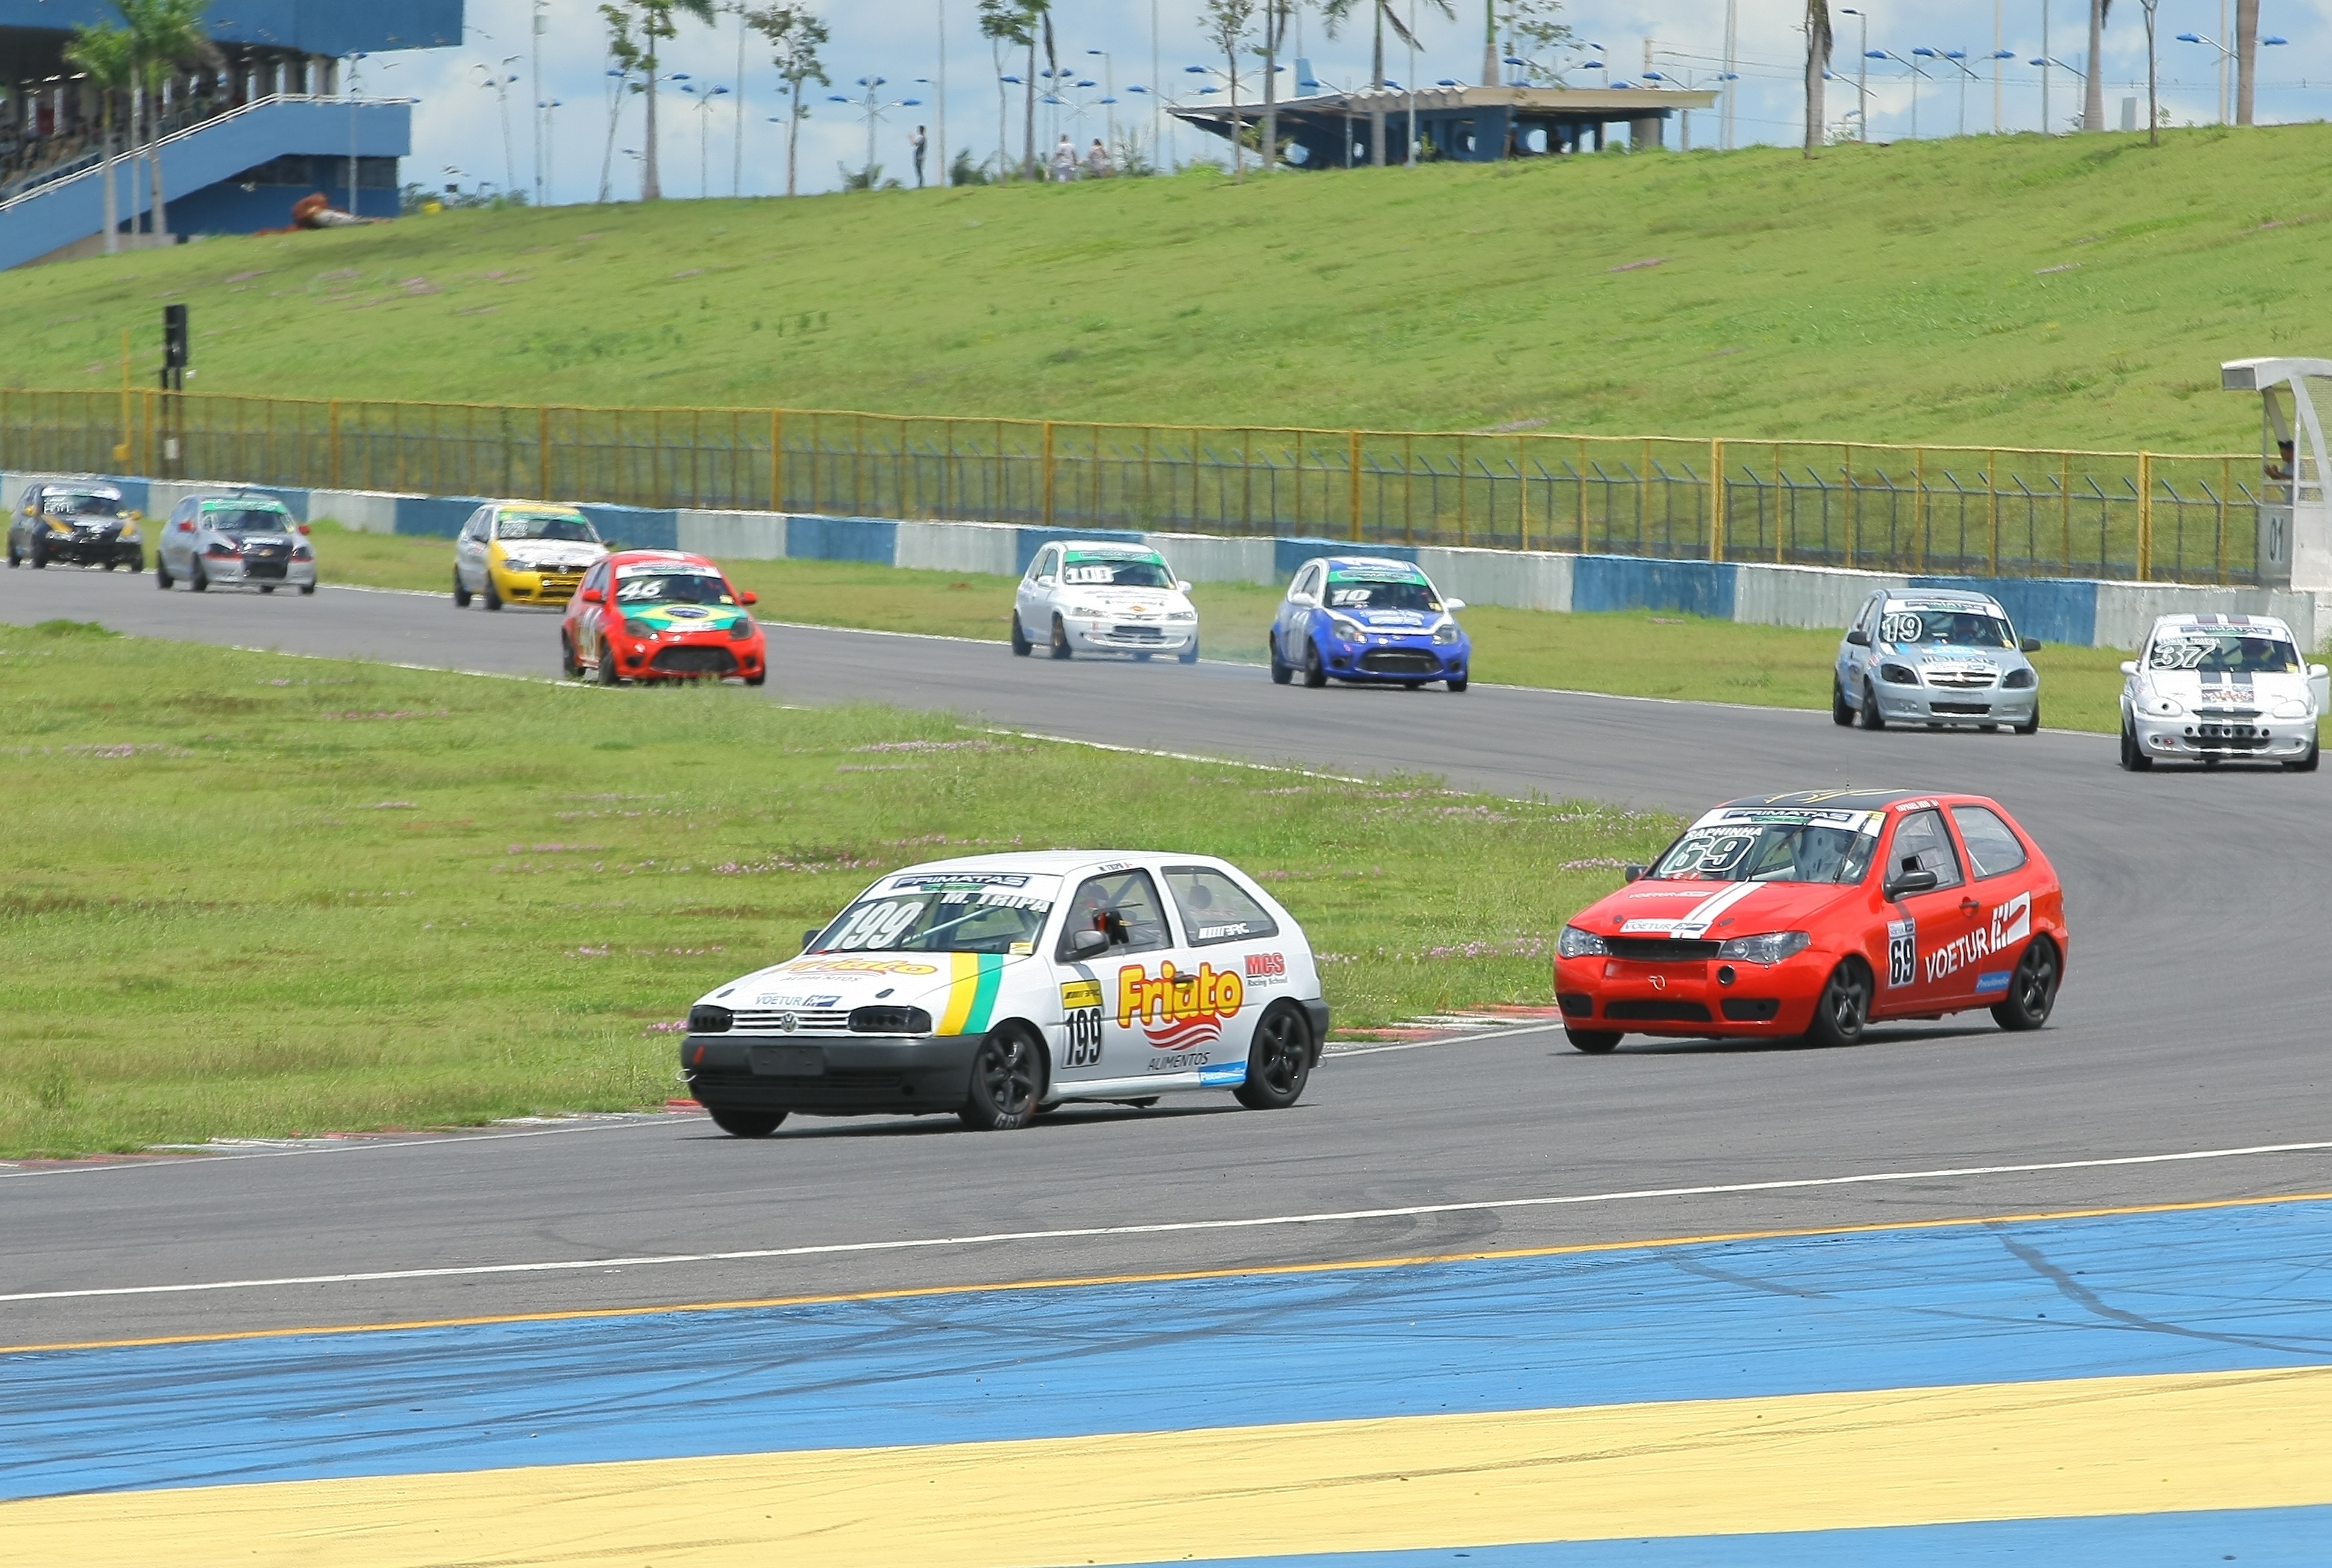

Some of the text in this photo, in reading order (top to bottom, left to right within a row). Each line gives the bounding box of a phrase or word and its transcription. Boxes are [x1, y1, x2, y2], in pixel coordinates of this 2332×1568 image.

[616, 580, 662, 600] 46
[1881, 613, 1922, 642] 19
[2151, 643, 2217, 669] 37
[1726, 810, 1850, 821] PRIMATAS
[1684, 827, 1763, 839] RAPHINHA
[1659, 835, 1756, 874] 69
[895, 876, 1026, 888] PRIMATAS
[979, 894, 1050, 912] TRIPA
[824, 901, 924, 950] 199
[1625, 922, 1672, 930] VOETUR
[1246, 953, 1286, 977] MCS
[1891, 938, 1914, 984] 69
[1925, 927, 1990, 983] VOETUR
[755, 996, 803, 1006] VOETUR
[1118, 960, 1244, 1029] Friato
[1066, 1008, 1101, 1065] 199
[1147, 1052, 1211, 1070] ALIMENTOS
